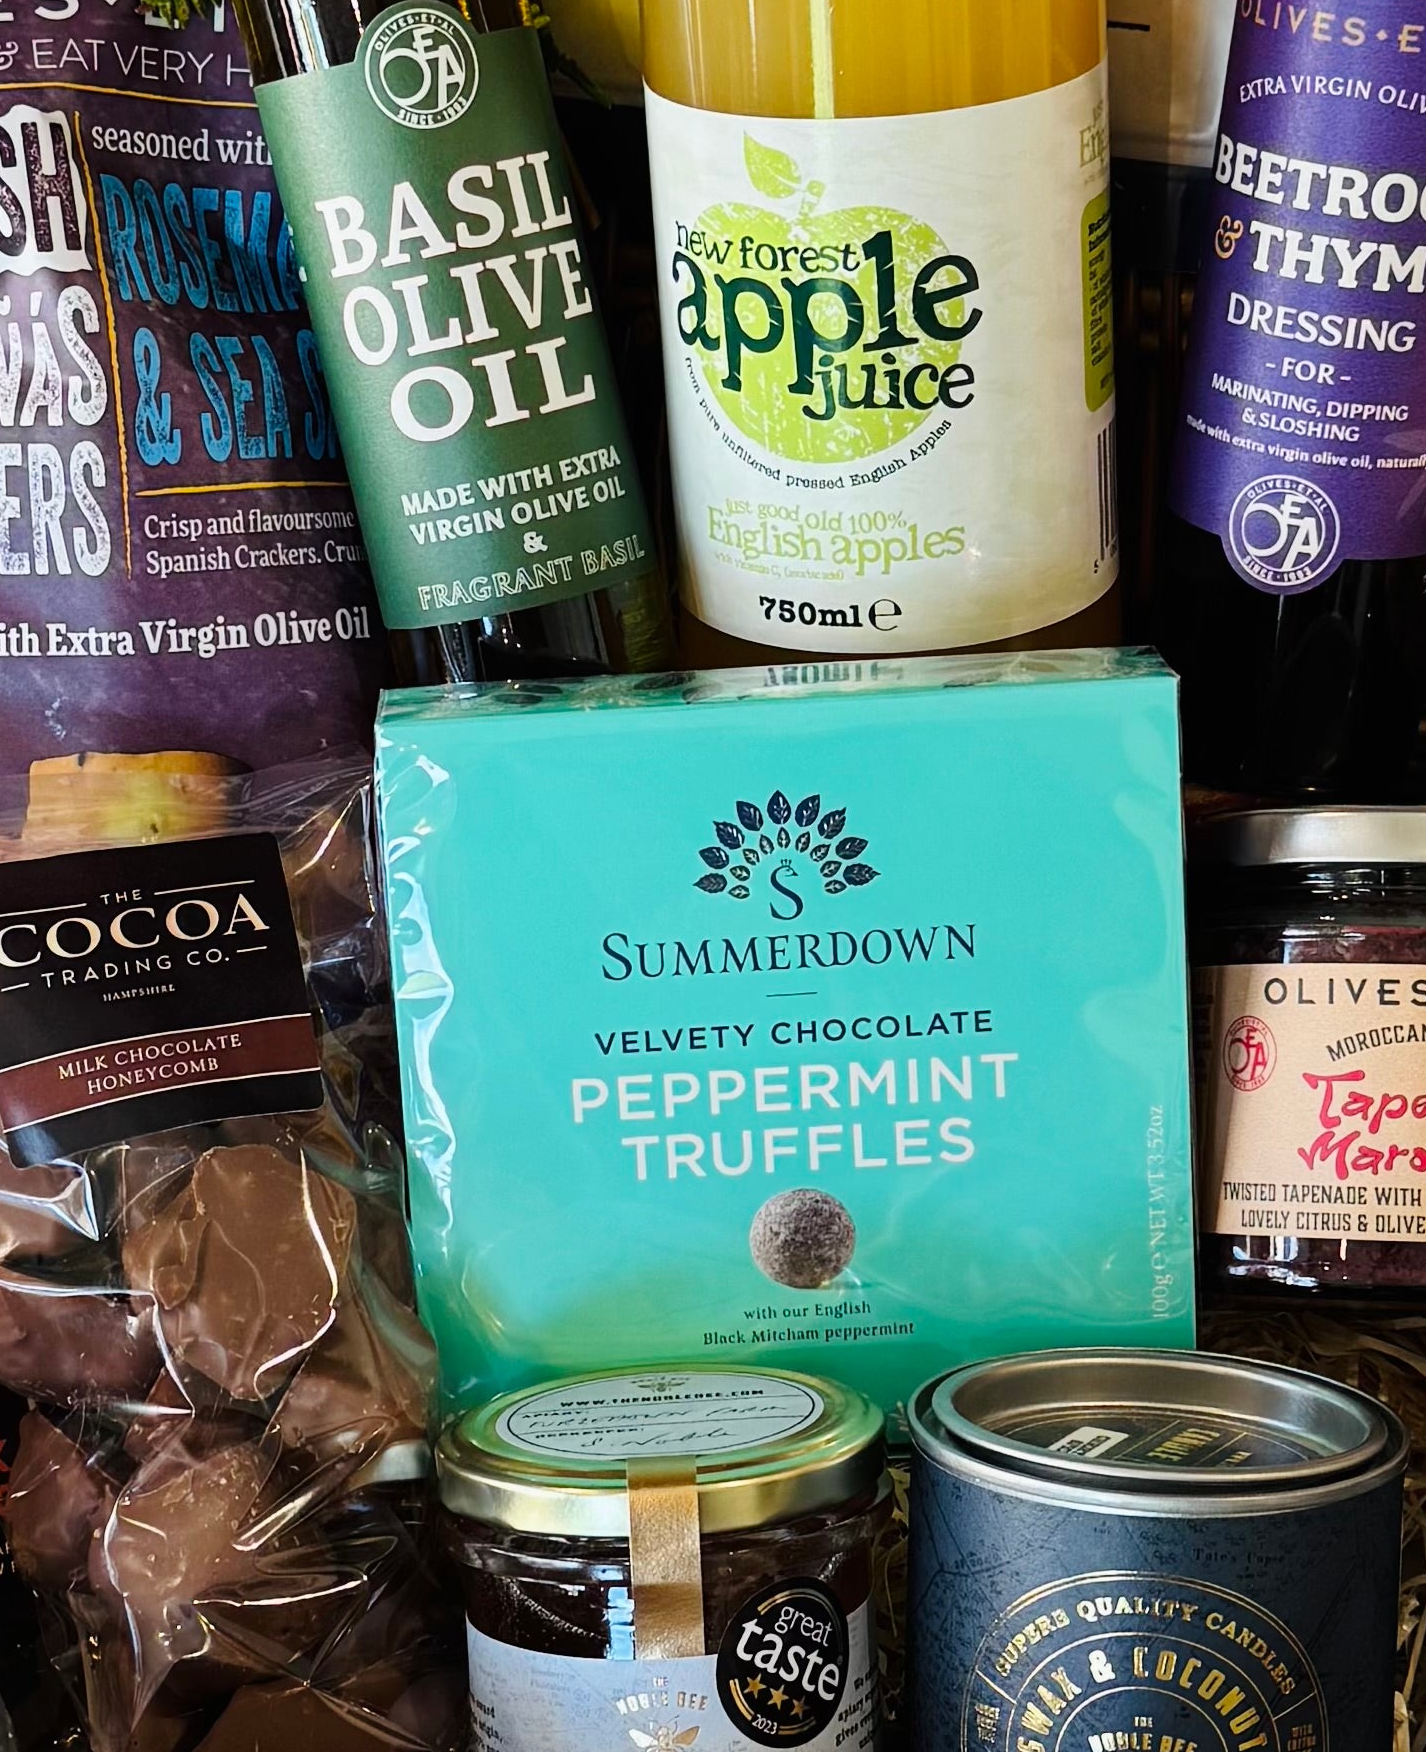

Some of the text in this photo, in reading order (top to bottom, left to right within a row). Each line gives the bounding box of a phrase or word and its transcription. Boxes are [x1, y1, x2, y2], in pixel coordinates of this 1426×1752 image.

[1239, 75, 1286, 103] EXTRA
[1290, 75, 1372, 101] VIRGIN
[315, 150, 572, 279] BASIL
[1214, 216, 1243, 259] &
[675, 221, 860, 272] new forest
[342, 239, 593, 367] OLIVE
[672, 230, 983, 394] apple
[1227, 292, 1417, 353] DRESSING
[390, 337, 596, 443] OIL
[802, 352, 975, 421] juice
[46, 623, 134, 658] Extra
[139, 619, 248, 658] Virgin
[254, 612, 329, 646] Olive
[335, 607, 371, 641] Oil
[759, 596, 862, 628] 750ml
[99, 888, 142, 907] THE
[40, 947, 231, 989] TRADING CO.
[601, 923, 977, 982] SUMMERDOWN
[58, 1033, 242, 1081] MILK CHOCOLATE
[87, 1059, 219, 1096] HONEYCOMB
[572, 1052, 1020, 1124] PEPPERMINT
[622, 1117, 975, 1181] TRUFFLES
[735, 1618, 840, 1702] taste
[750, 1713, 779, 1736] 2023
